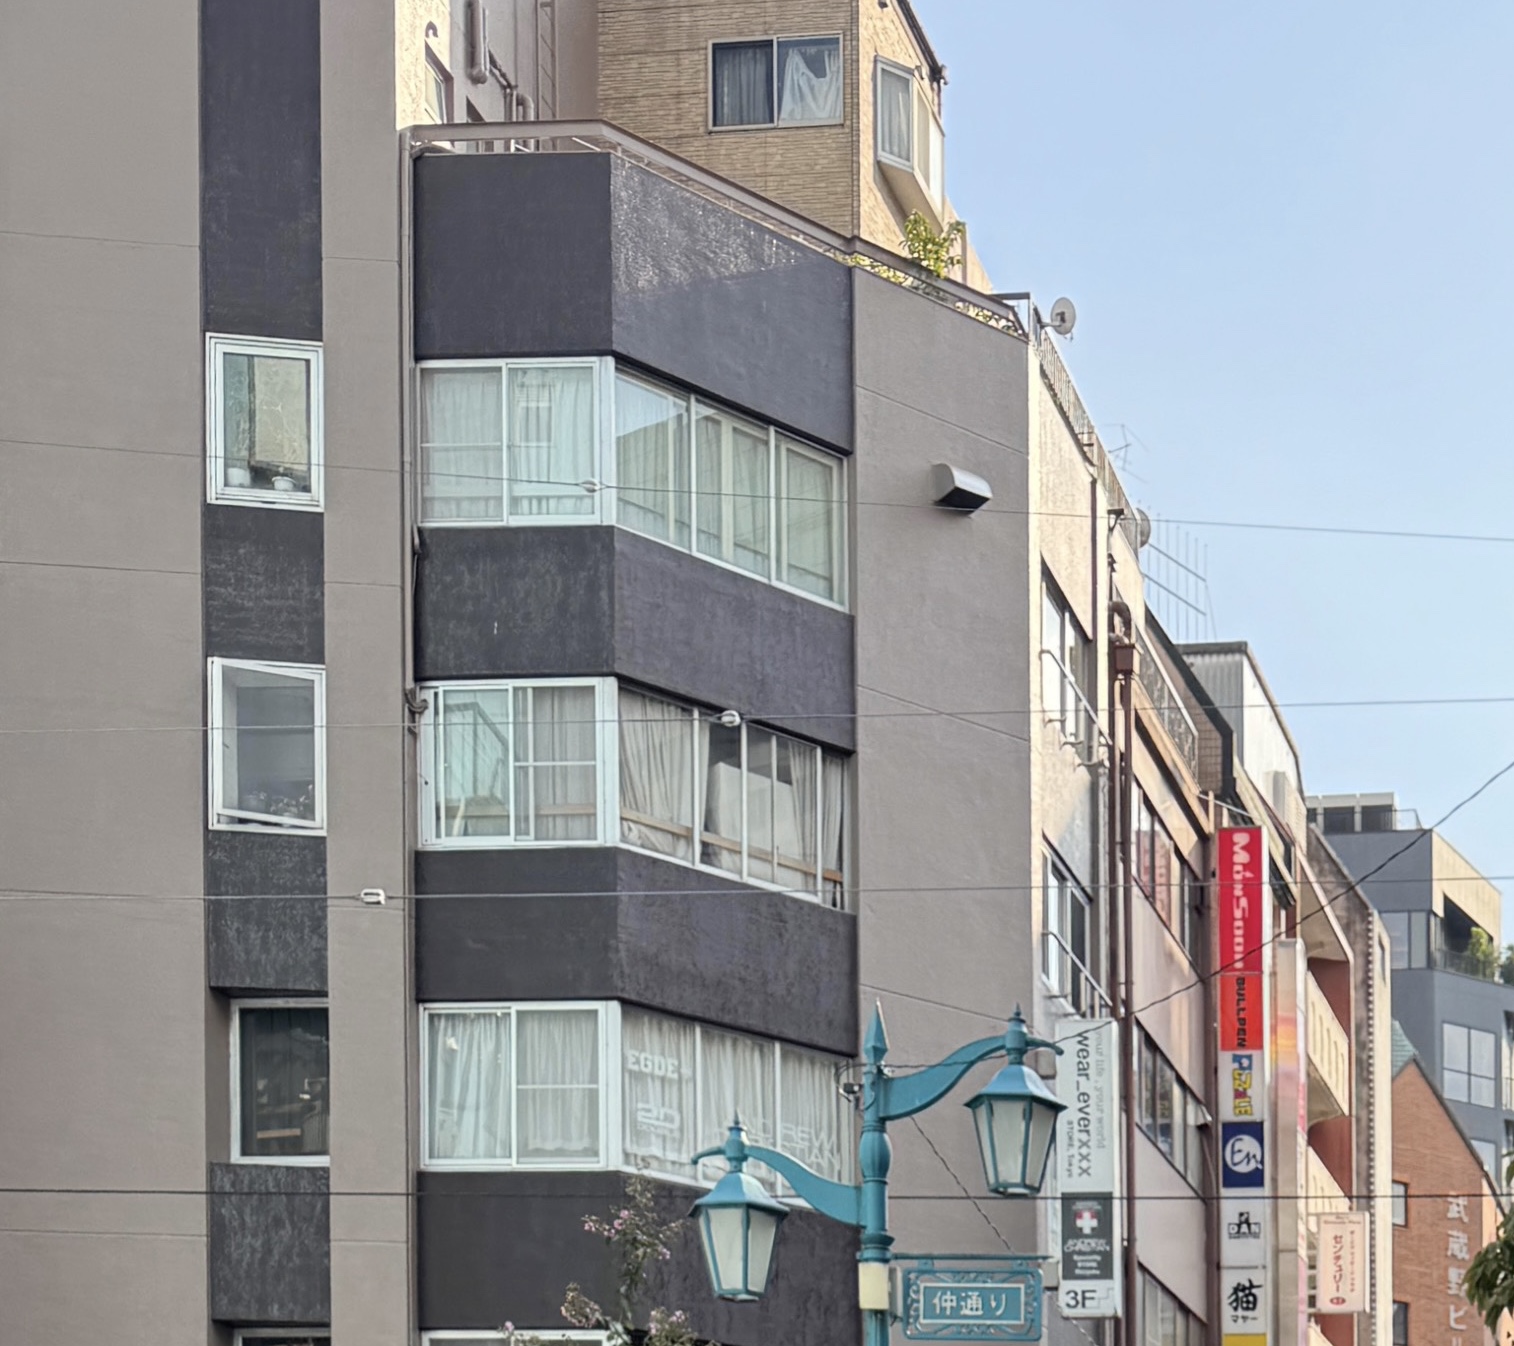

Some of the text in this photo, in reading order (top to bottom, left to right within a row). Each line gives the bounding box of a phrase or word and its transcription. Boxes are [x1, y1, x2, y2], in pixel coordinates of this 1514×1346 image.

[1228, 1222, 1261, 1235] DAN
[931, 1290, 1007, 1317] 仲通り
[1065, 1289, 1097, 1310] 3F
[1227, 1278, 1263, 1312] 猫
